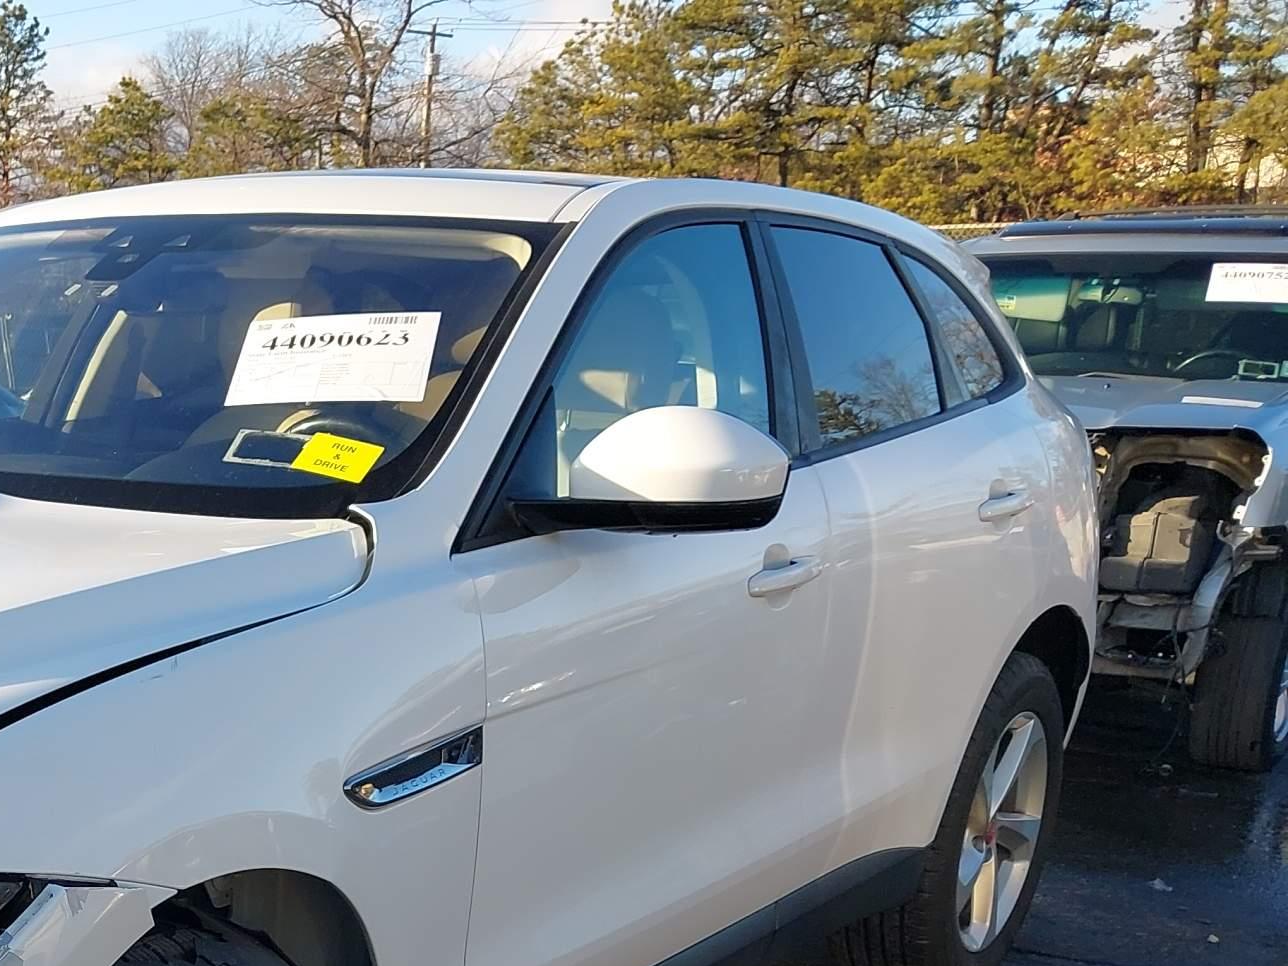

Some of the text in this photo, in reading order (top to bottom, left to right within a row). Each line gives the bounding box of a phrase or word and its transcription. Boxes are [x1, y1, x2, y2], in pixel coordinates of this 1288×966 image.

[261, 330, 410, 351] 44090623
[331, 442, 357, 454] RUN
[333, 453, 341, 461] &
[313, 459, 349, 472] DRIVE
[392, 768, 446, 797] JAGUAR
